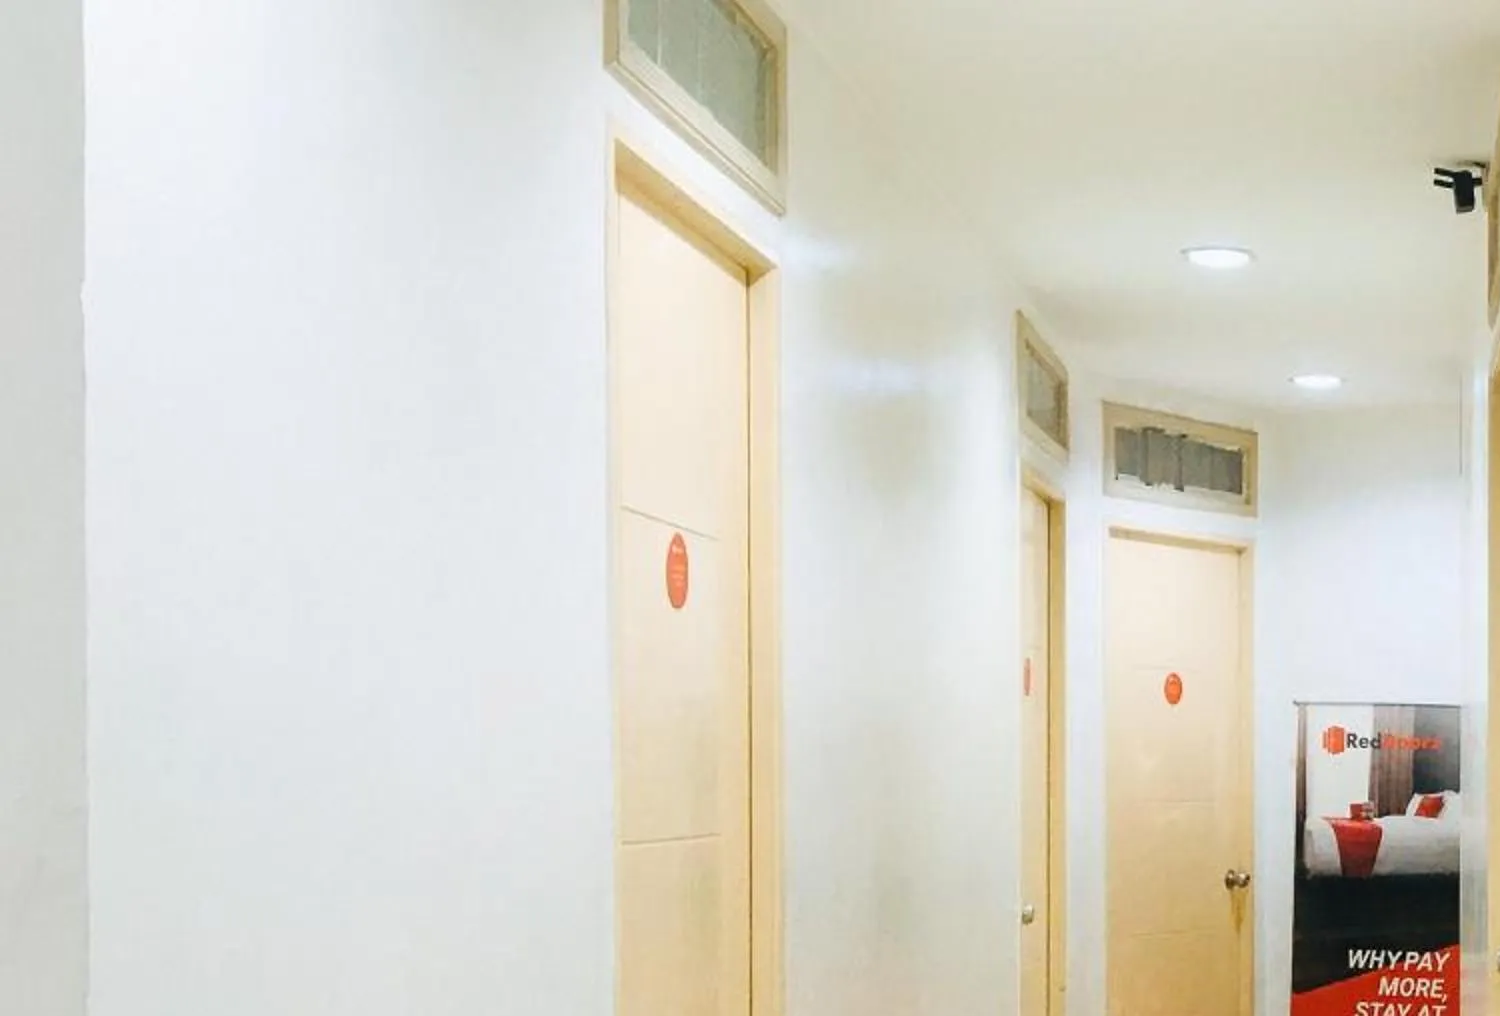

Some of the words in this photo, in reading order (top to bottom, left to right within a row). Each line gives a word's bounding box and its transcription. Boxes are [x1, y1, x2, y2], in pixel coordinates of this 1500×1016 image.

[1348, 949, 1401, 969] WHY
[1403, 951, 1450, 971] PAY
[1378, 976, 1448, 1002] MORE,
